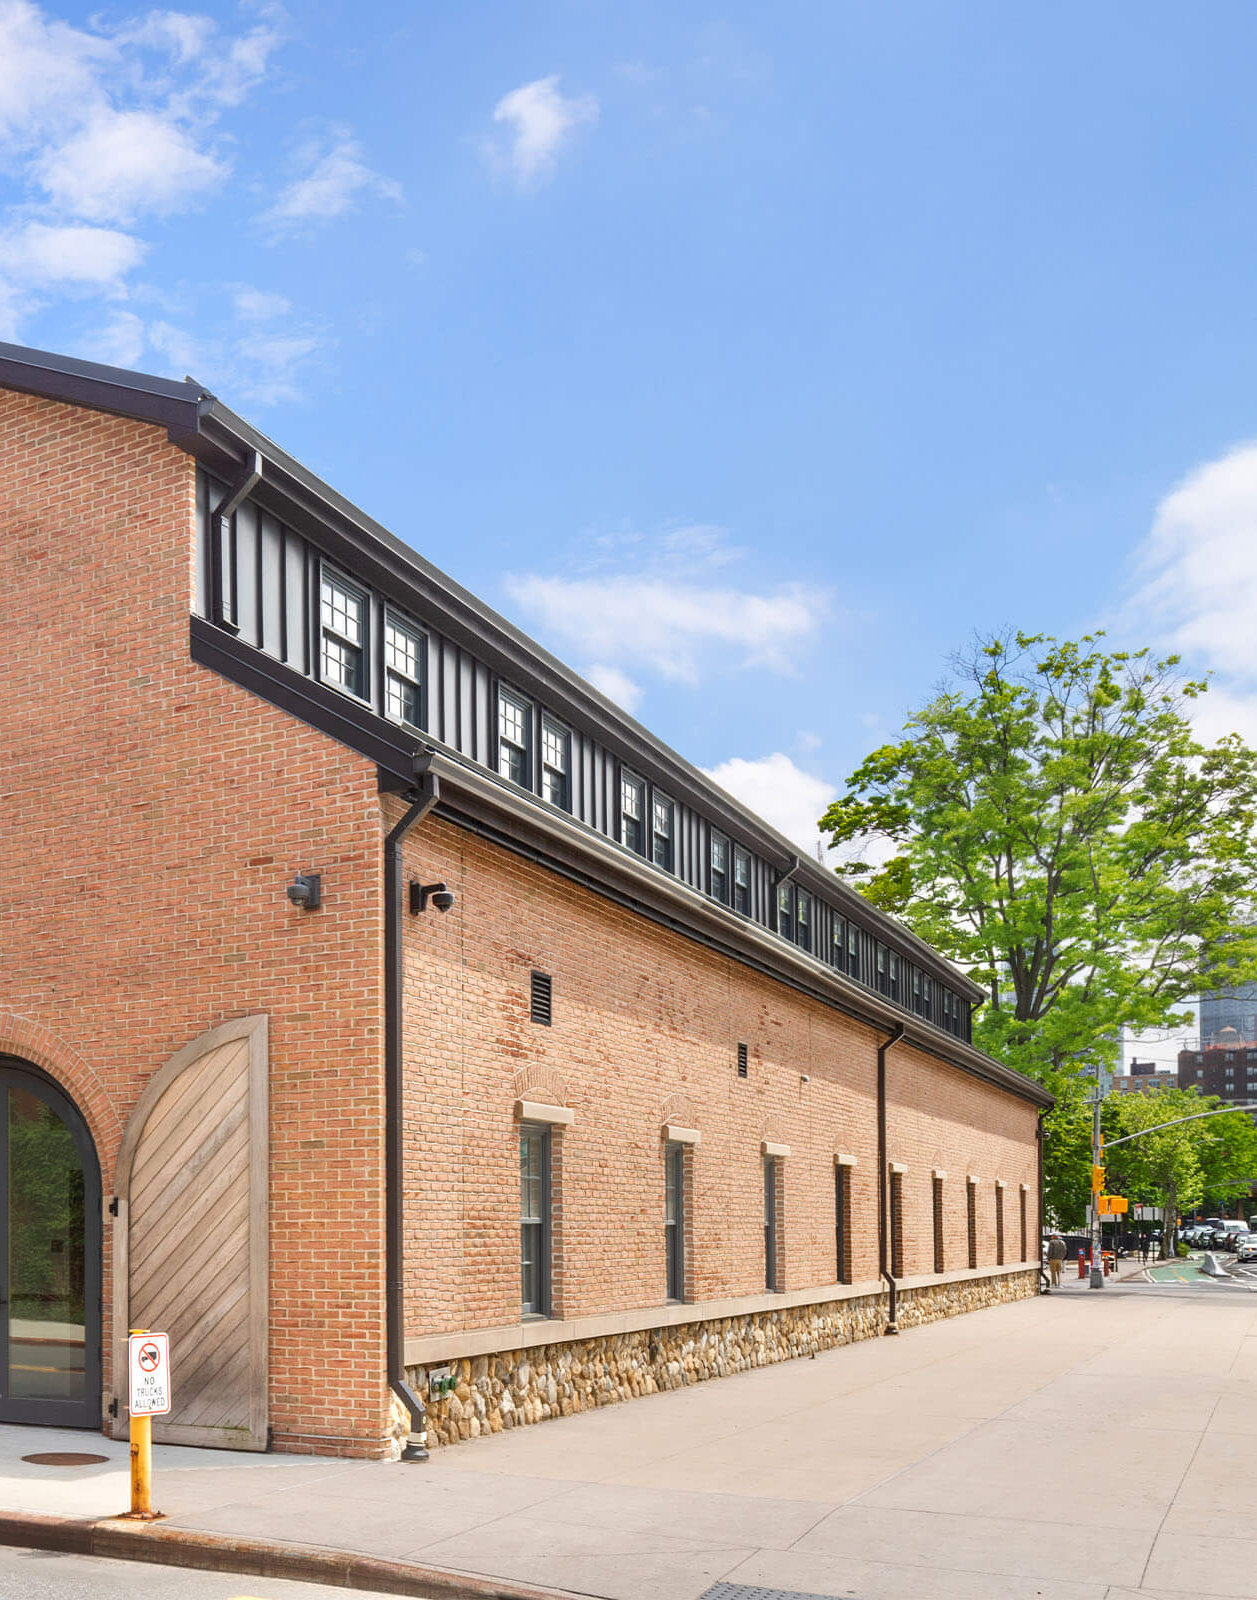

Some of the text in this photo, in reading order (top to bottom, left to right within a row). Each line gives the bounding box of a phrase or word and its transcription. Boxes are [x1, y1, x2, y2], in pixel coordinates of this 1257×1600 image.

[144, 1376, 155, 1385] NO
[137, 1386, 162, 1397] TRUCKS
[135, 1397, 165, 1408] ALLOWED
